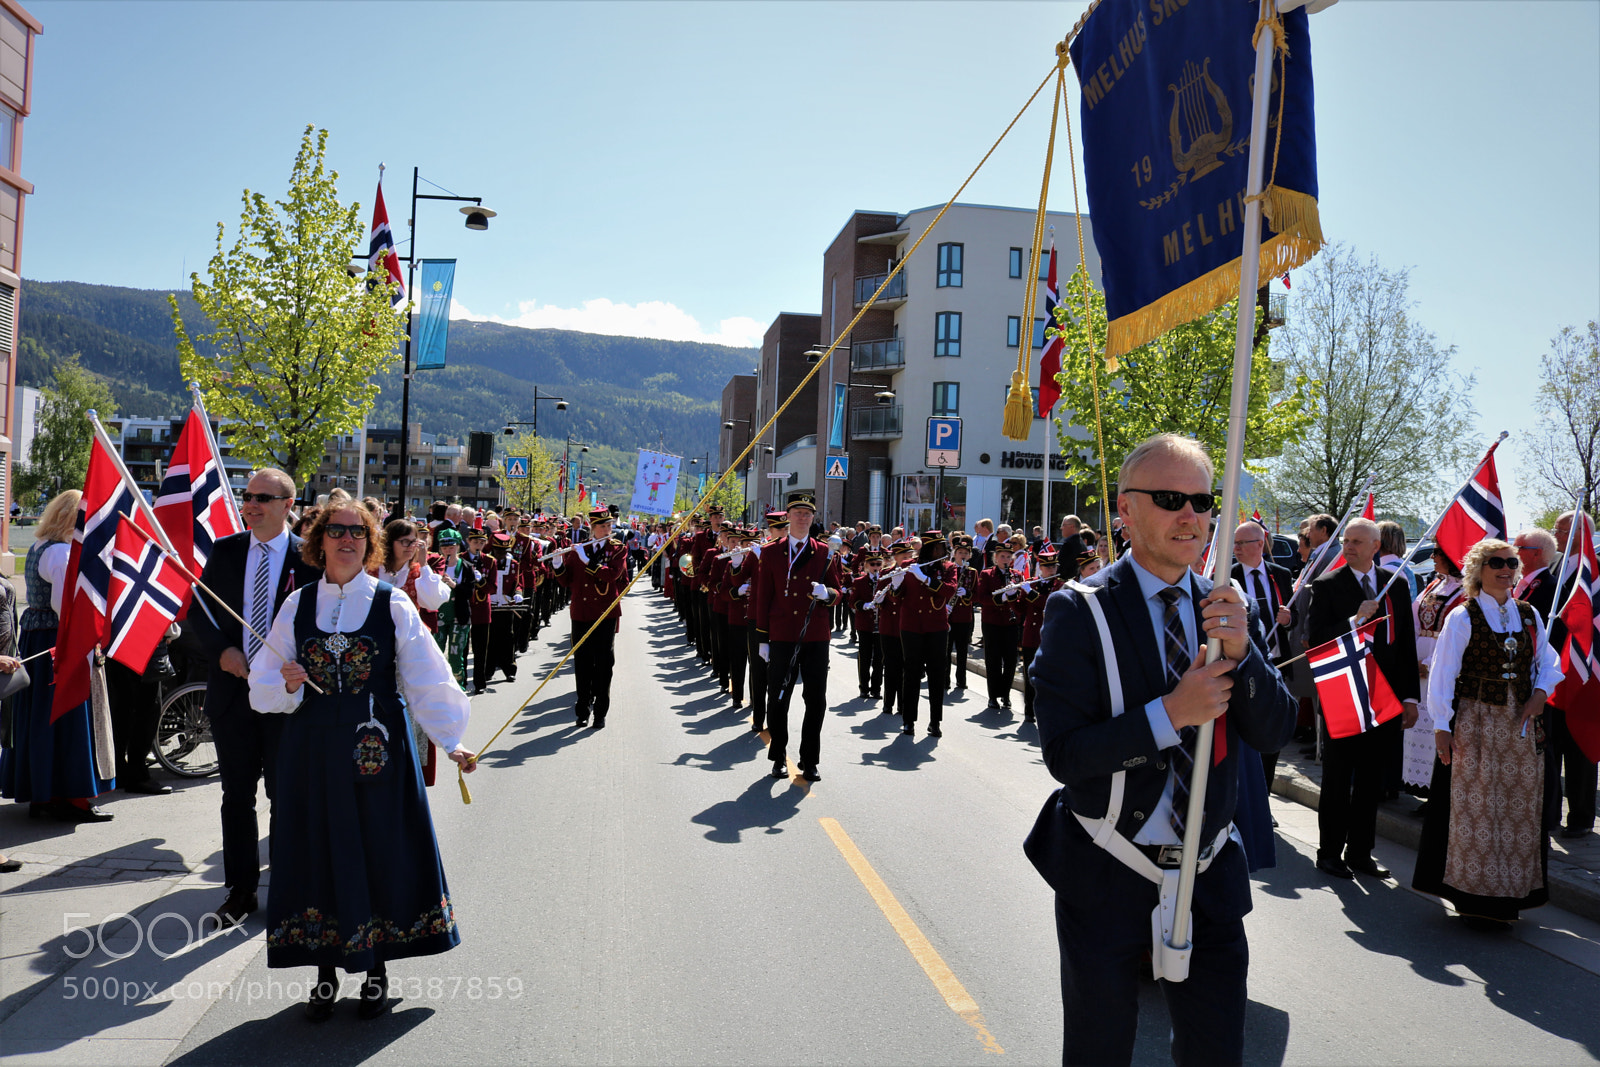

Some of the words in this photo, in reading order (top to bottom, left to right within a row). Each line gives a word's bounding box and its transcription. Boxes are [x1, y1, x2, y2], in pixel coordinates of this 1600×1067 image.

[1082, 11, 1147, 110] MELHUS
[1150, 0, 1189, 27] SK
[1131, 155, 1153, 188] 19
[936, 423, 952, 446] P
[1001, 451, 1087, 471] HØVDNG
